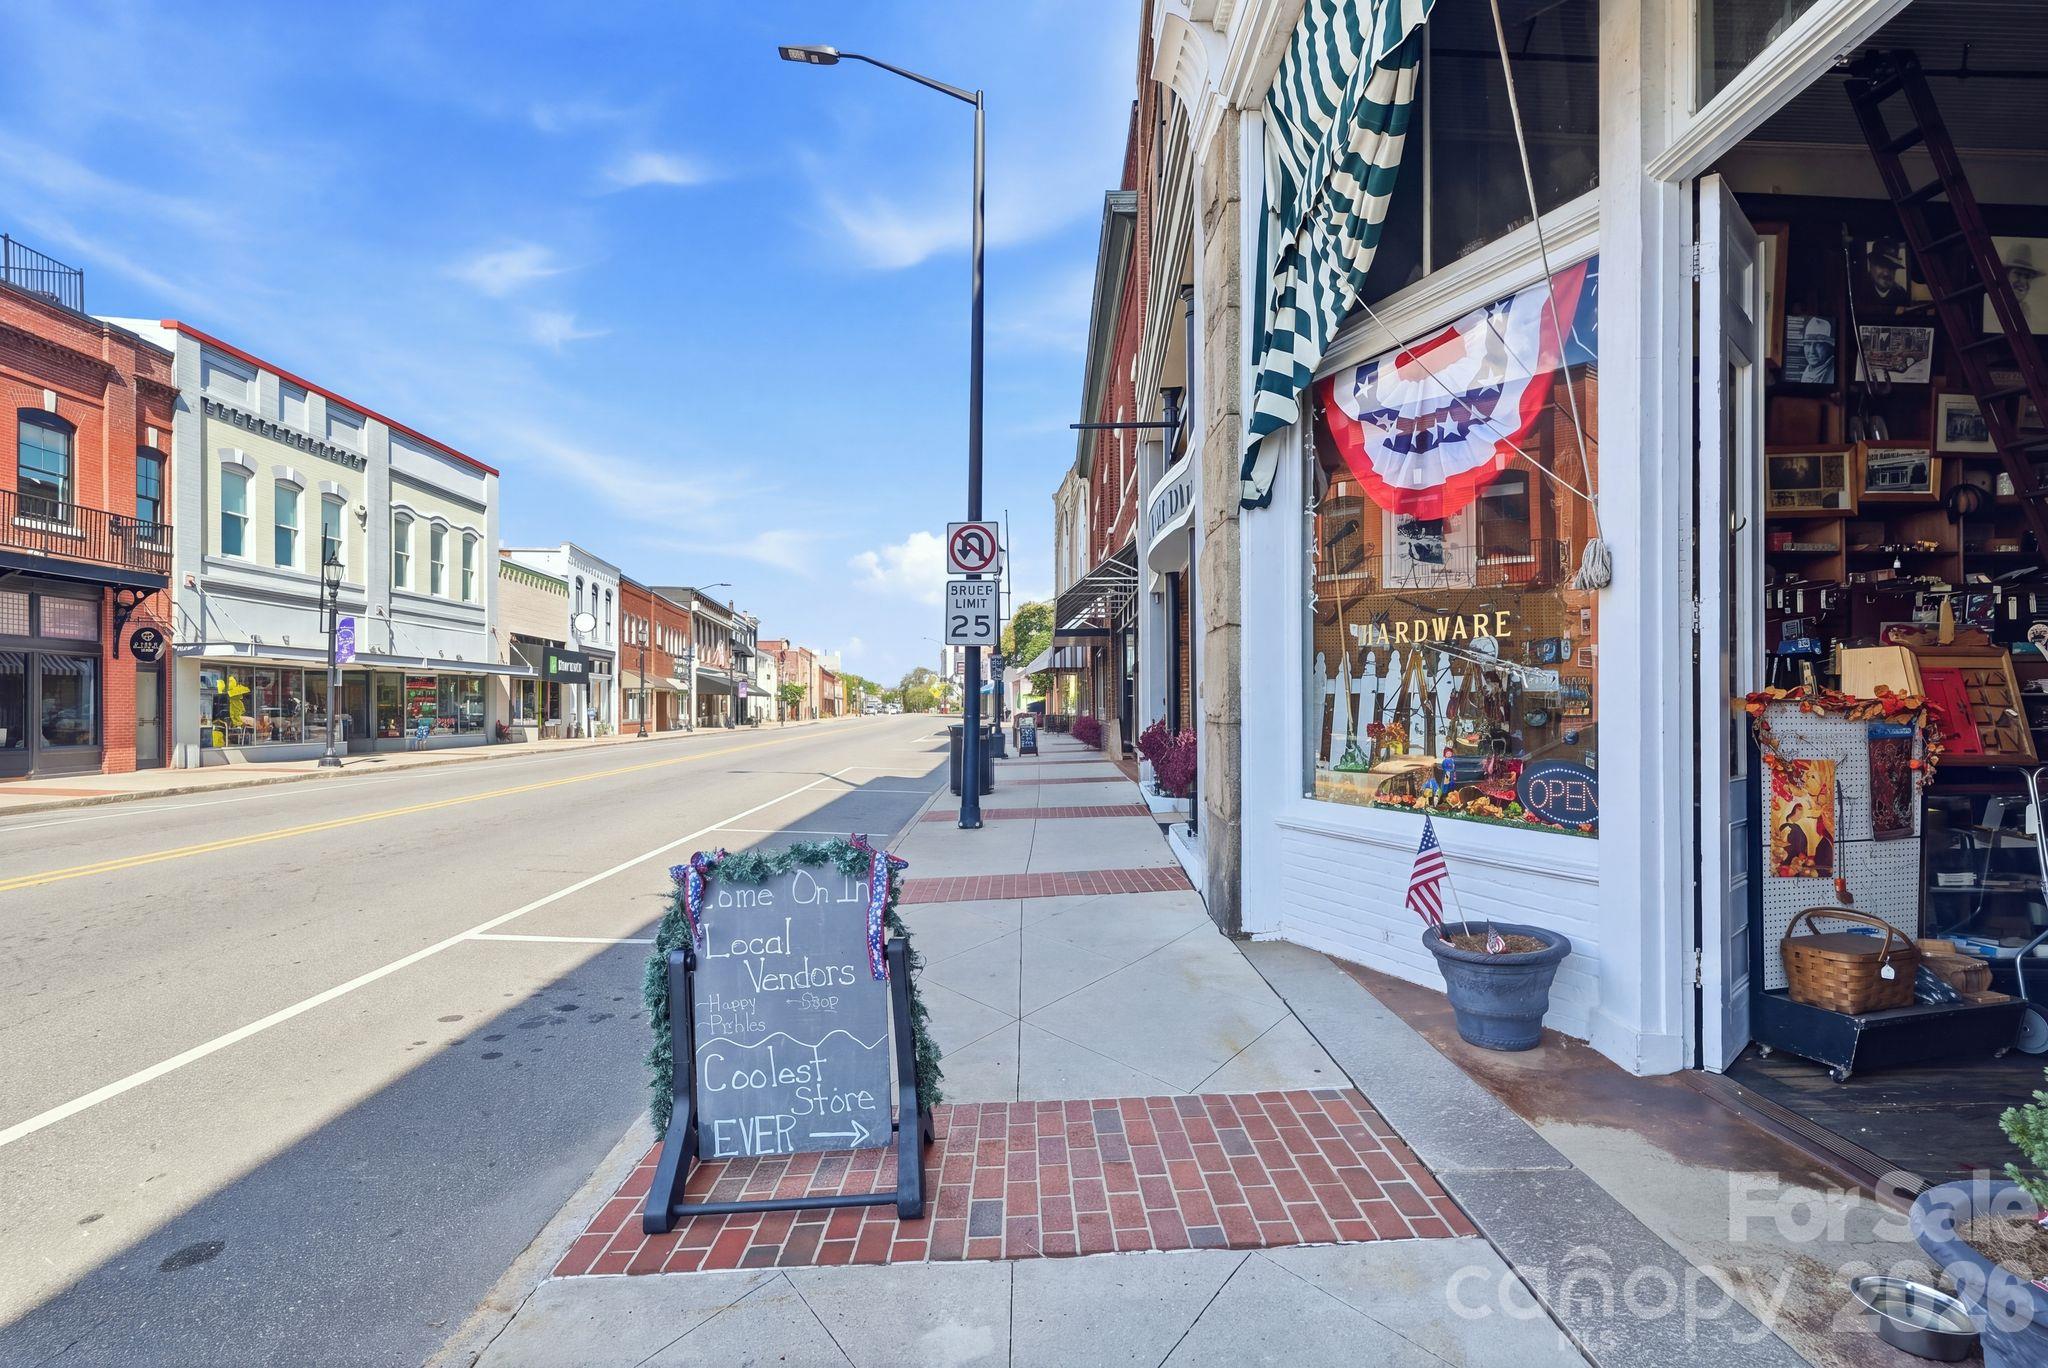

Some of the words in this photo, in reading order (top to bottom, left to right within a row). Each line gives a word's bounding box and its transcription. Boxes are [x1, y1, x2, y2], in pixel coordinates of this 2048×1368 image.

[955, 598, 988, 609] LIMIT
[950, 614, 991, 638] 25
[1358, 610, 1513, 646] HARDWARE
[1528, 778, 1599, 812] OPEN
[705, 887, 775, 910] ome
[792, 869, 829, 905] On
[703, 917, 792, 960] Local
[743, 955, 856, 993] Vendors
[708, 993, 757, 1016] Happy
[704, 1046, 828, 1093] Coolest
[790, 1083, 876, 1117] Store
[713, 1114, 797, 1158] EVER
